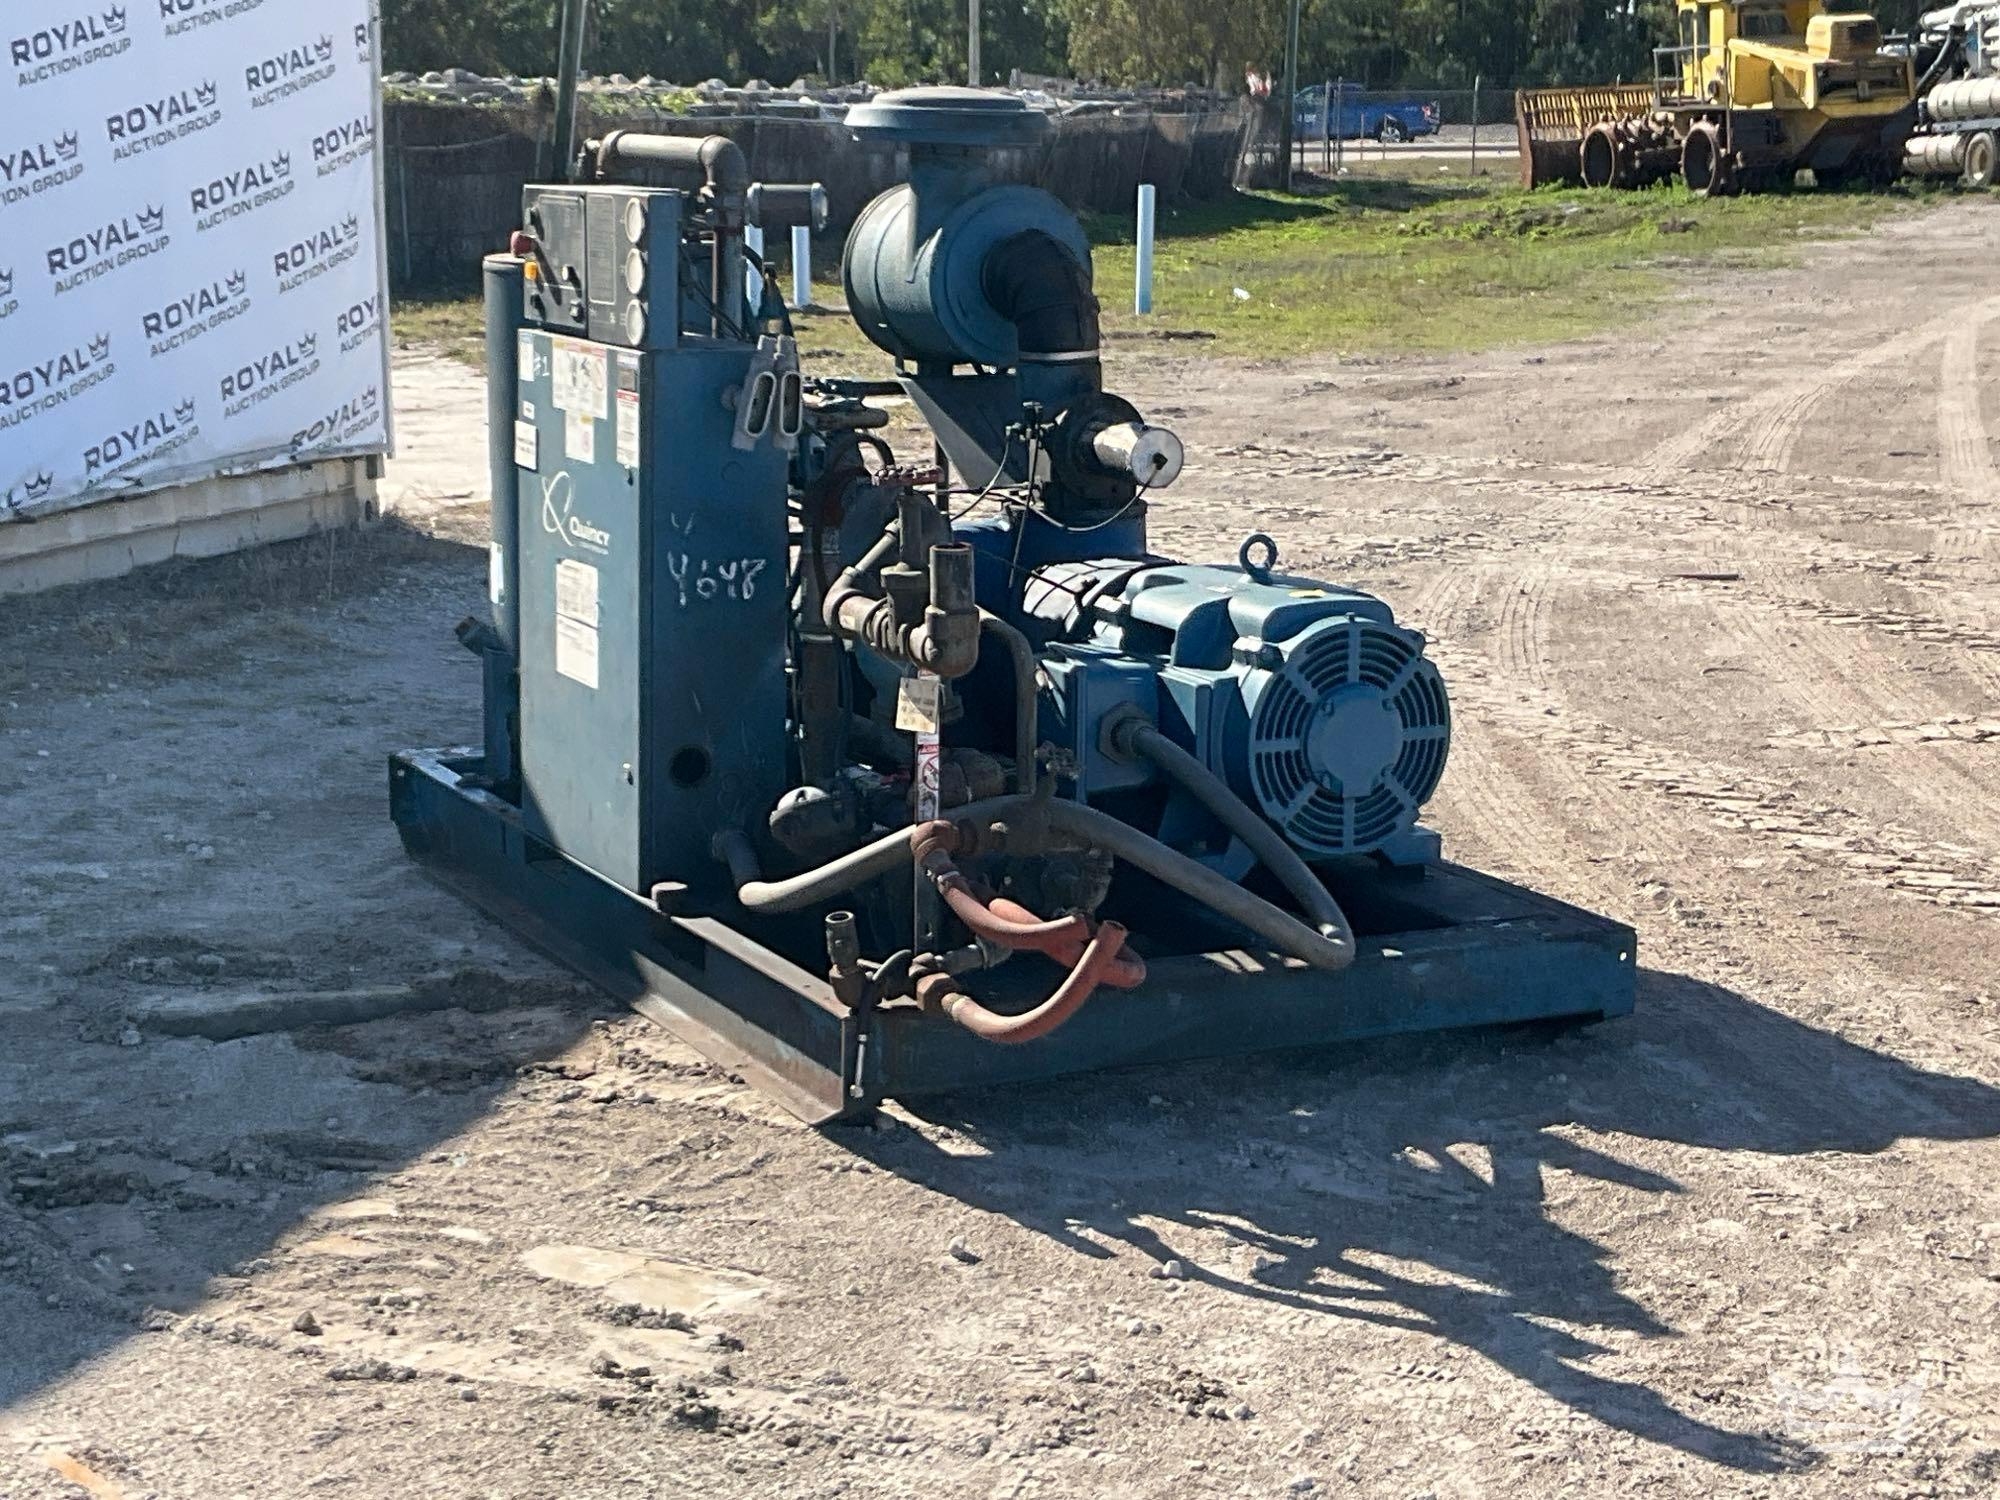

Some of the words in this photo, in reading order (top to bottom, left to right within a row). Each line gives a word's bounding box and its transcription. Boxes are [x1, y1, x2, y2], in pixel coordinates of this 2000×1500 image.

[11, 15, 105, 66] ROYAL
[18, 55, 82, 87] AUCTION
[84, 37, 131, 64] GROUP
[246, 46, 315, 91] ROYAL
[107, 91, 198, 142] ROYAL
[114, 129, 176, 162] AUCTION
[177, 109, 221, 137] GROUP
[312, 114, 376, 161] ROYAL
[0, 144, 56, 181] YAL
[32, 163, 83, 193] GROUP
[190, 163, 273, 214] ROYAL
[196, 200, 252, 232] AUCTION
[254, 179, 295, 207] GROUP
[46, 218, 139, 275] ROYAL
[55, 257, 114, 296] AUCTION
[117, 235, 170, 266] GROUP
[274, 226, 343, 276] ROYAL
[279, 262, 328, 295] AUCTION
[143, 282, 228, 339] ROYAL
[150, 321, 207, 357] AUCTION
[208, 298, 251, 328] GROUP
[70, 363, 116, 396] GROUP
[221, 345, 299, 401] ROYAL
[224, 382, 278, 419] AUCTION
[280, 359, 320, 389] GROUP
[83, 412, 176, 475] ROYAL
